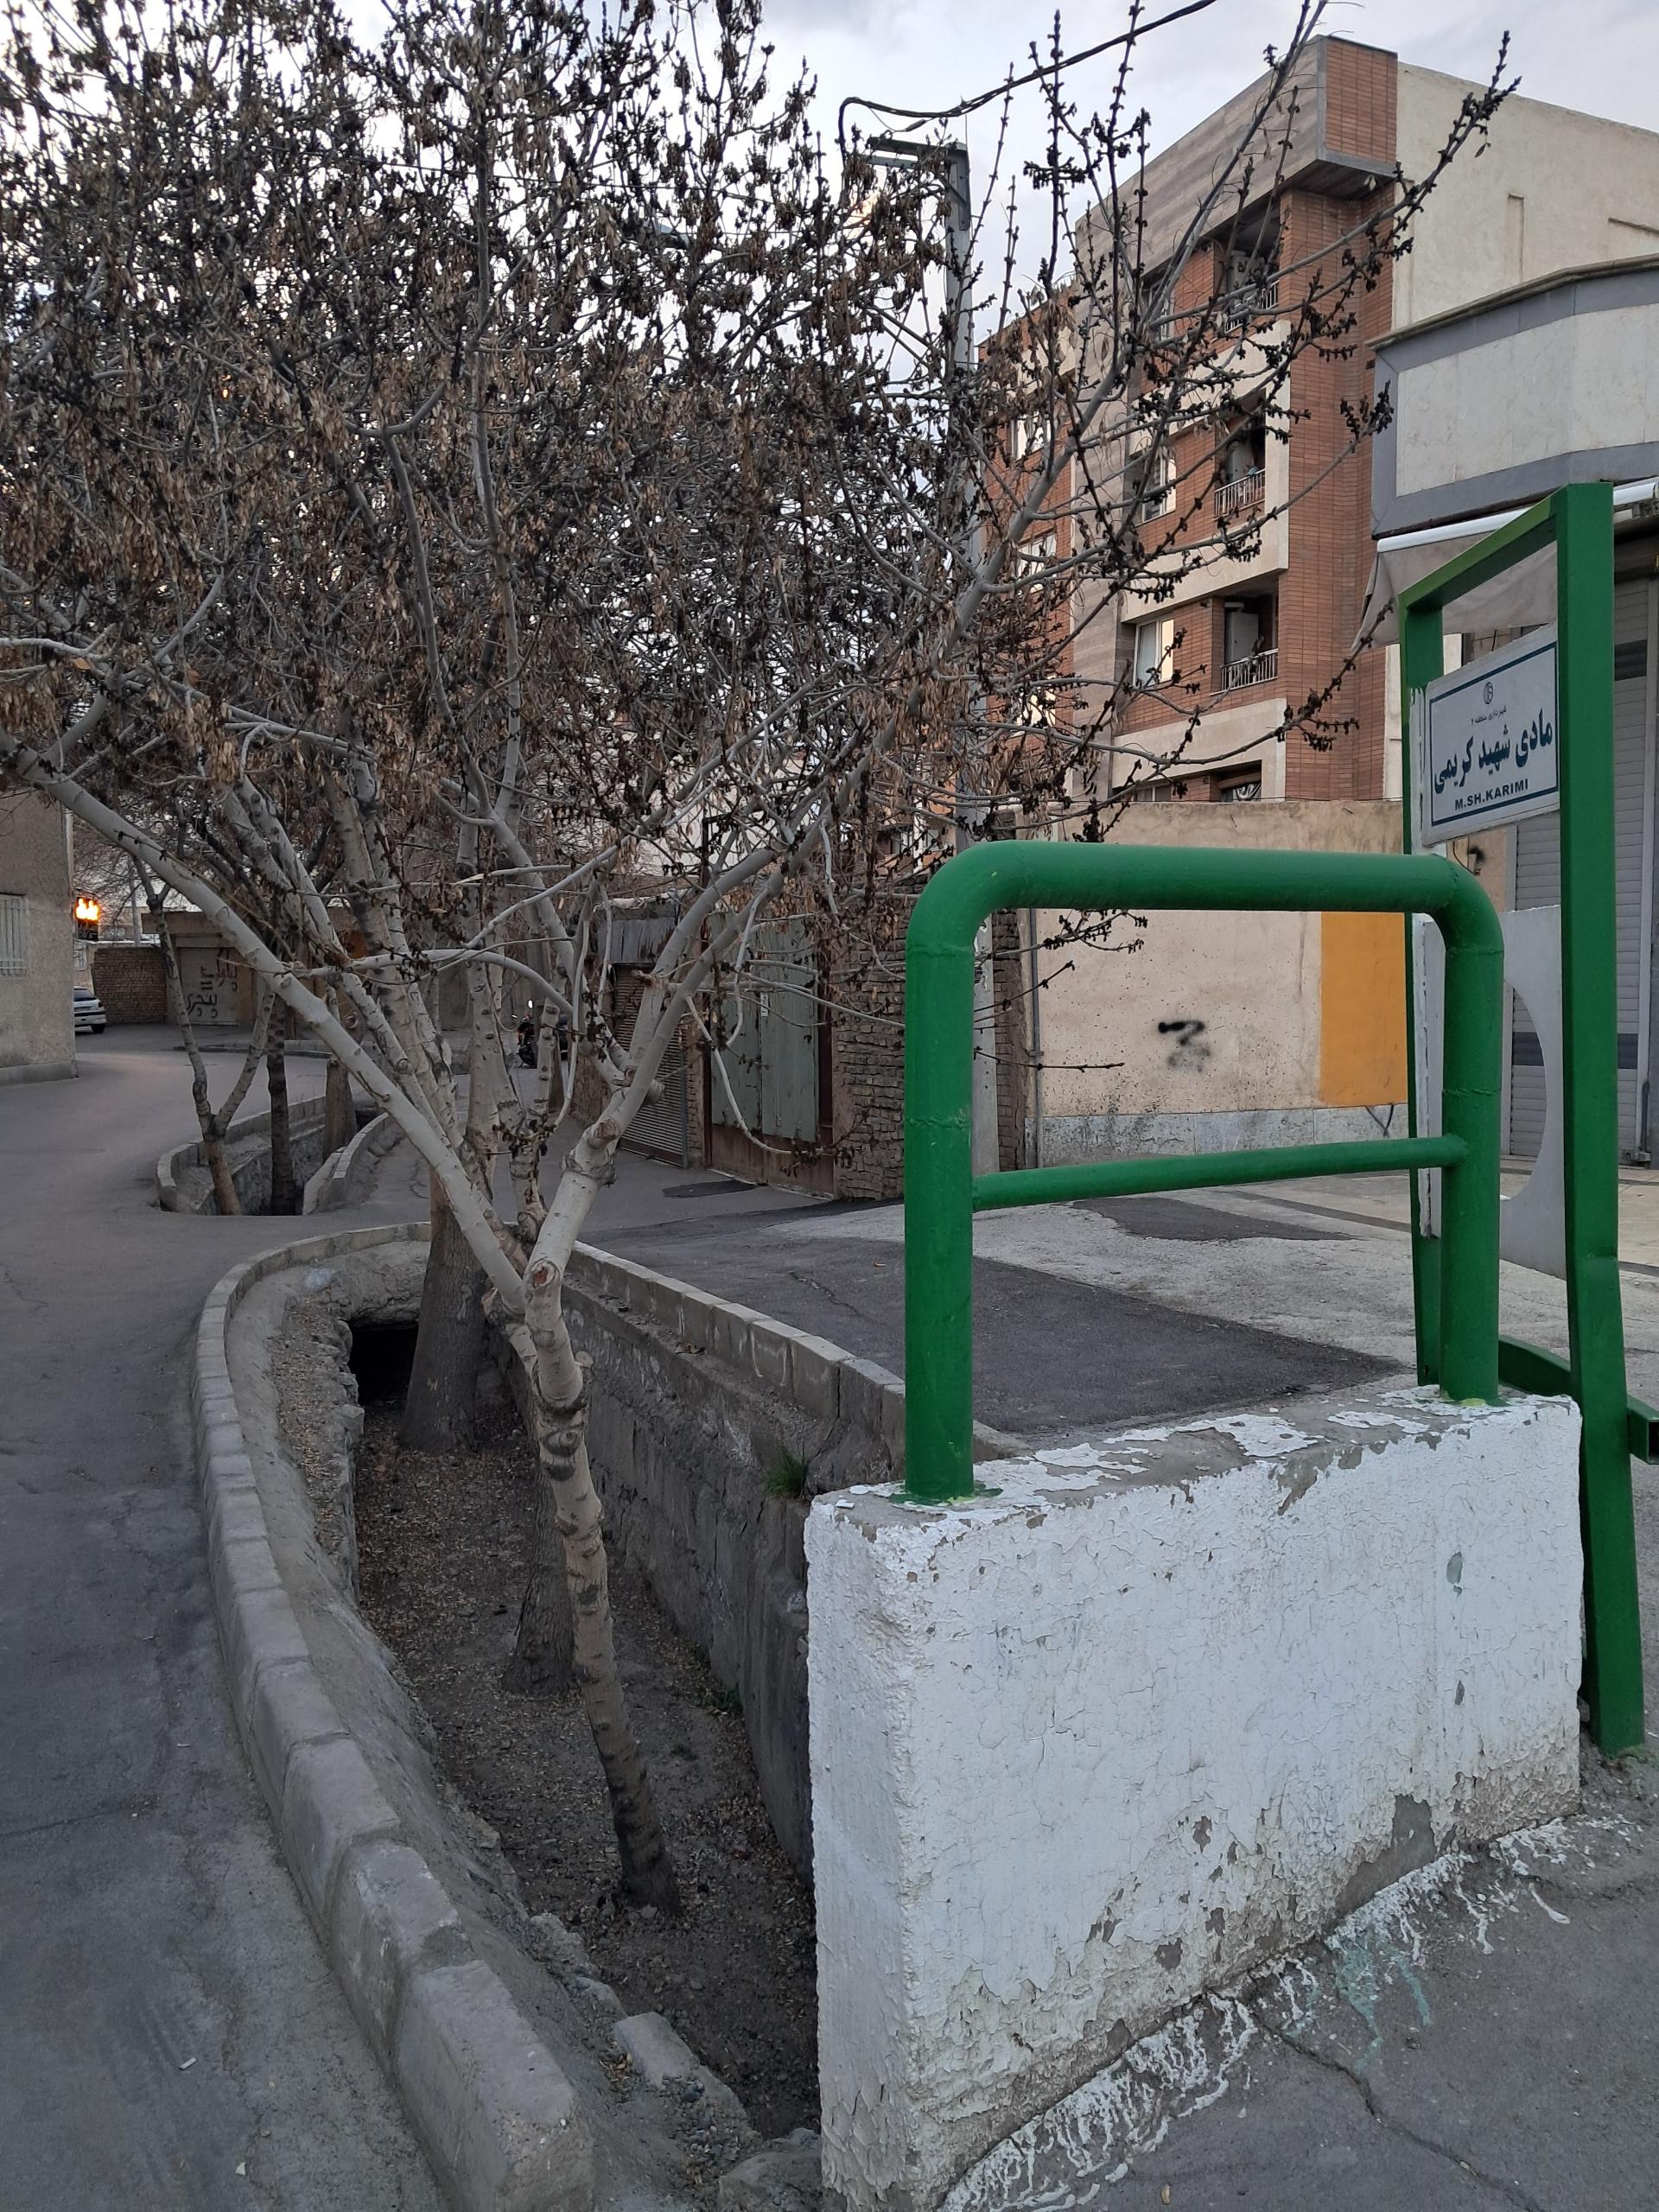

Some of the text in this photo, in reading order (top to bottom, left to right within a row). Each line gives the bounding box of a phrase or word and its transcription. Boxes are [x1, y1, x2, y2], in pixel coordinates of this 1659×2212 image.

[1475, 715, 1488, 724] منطقه
[1488, 705, 1507, 721] شهرداری
[1434, 708, 1553, 794] مادی شهید کریمی
[1454, 778, 1529, 810] M.SH.KARIMI
